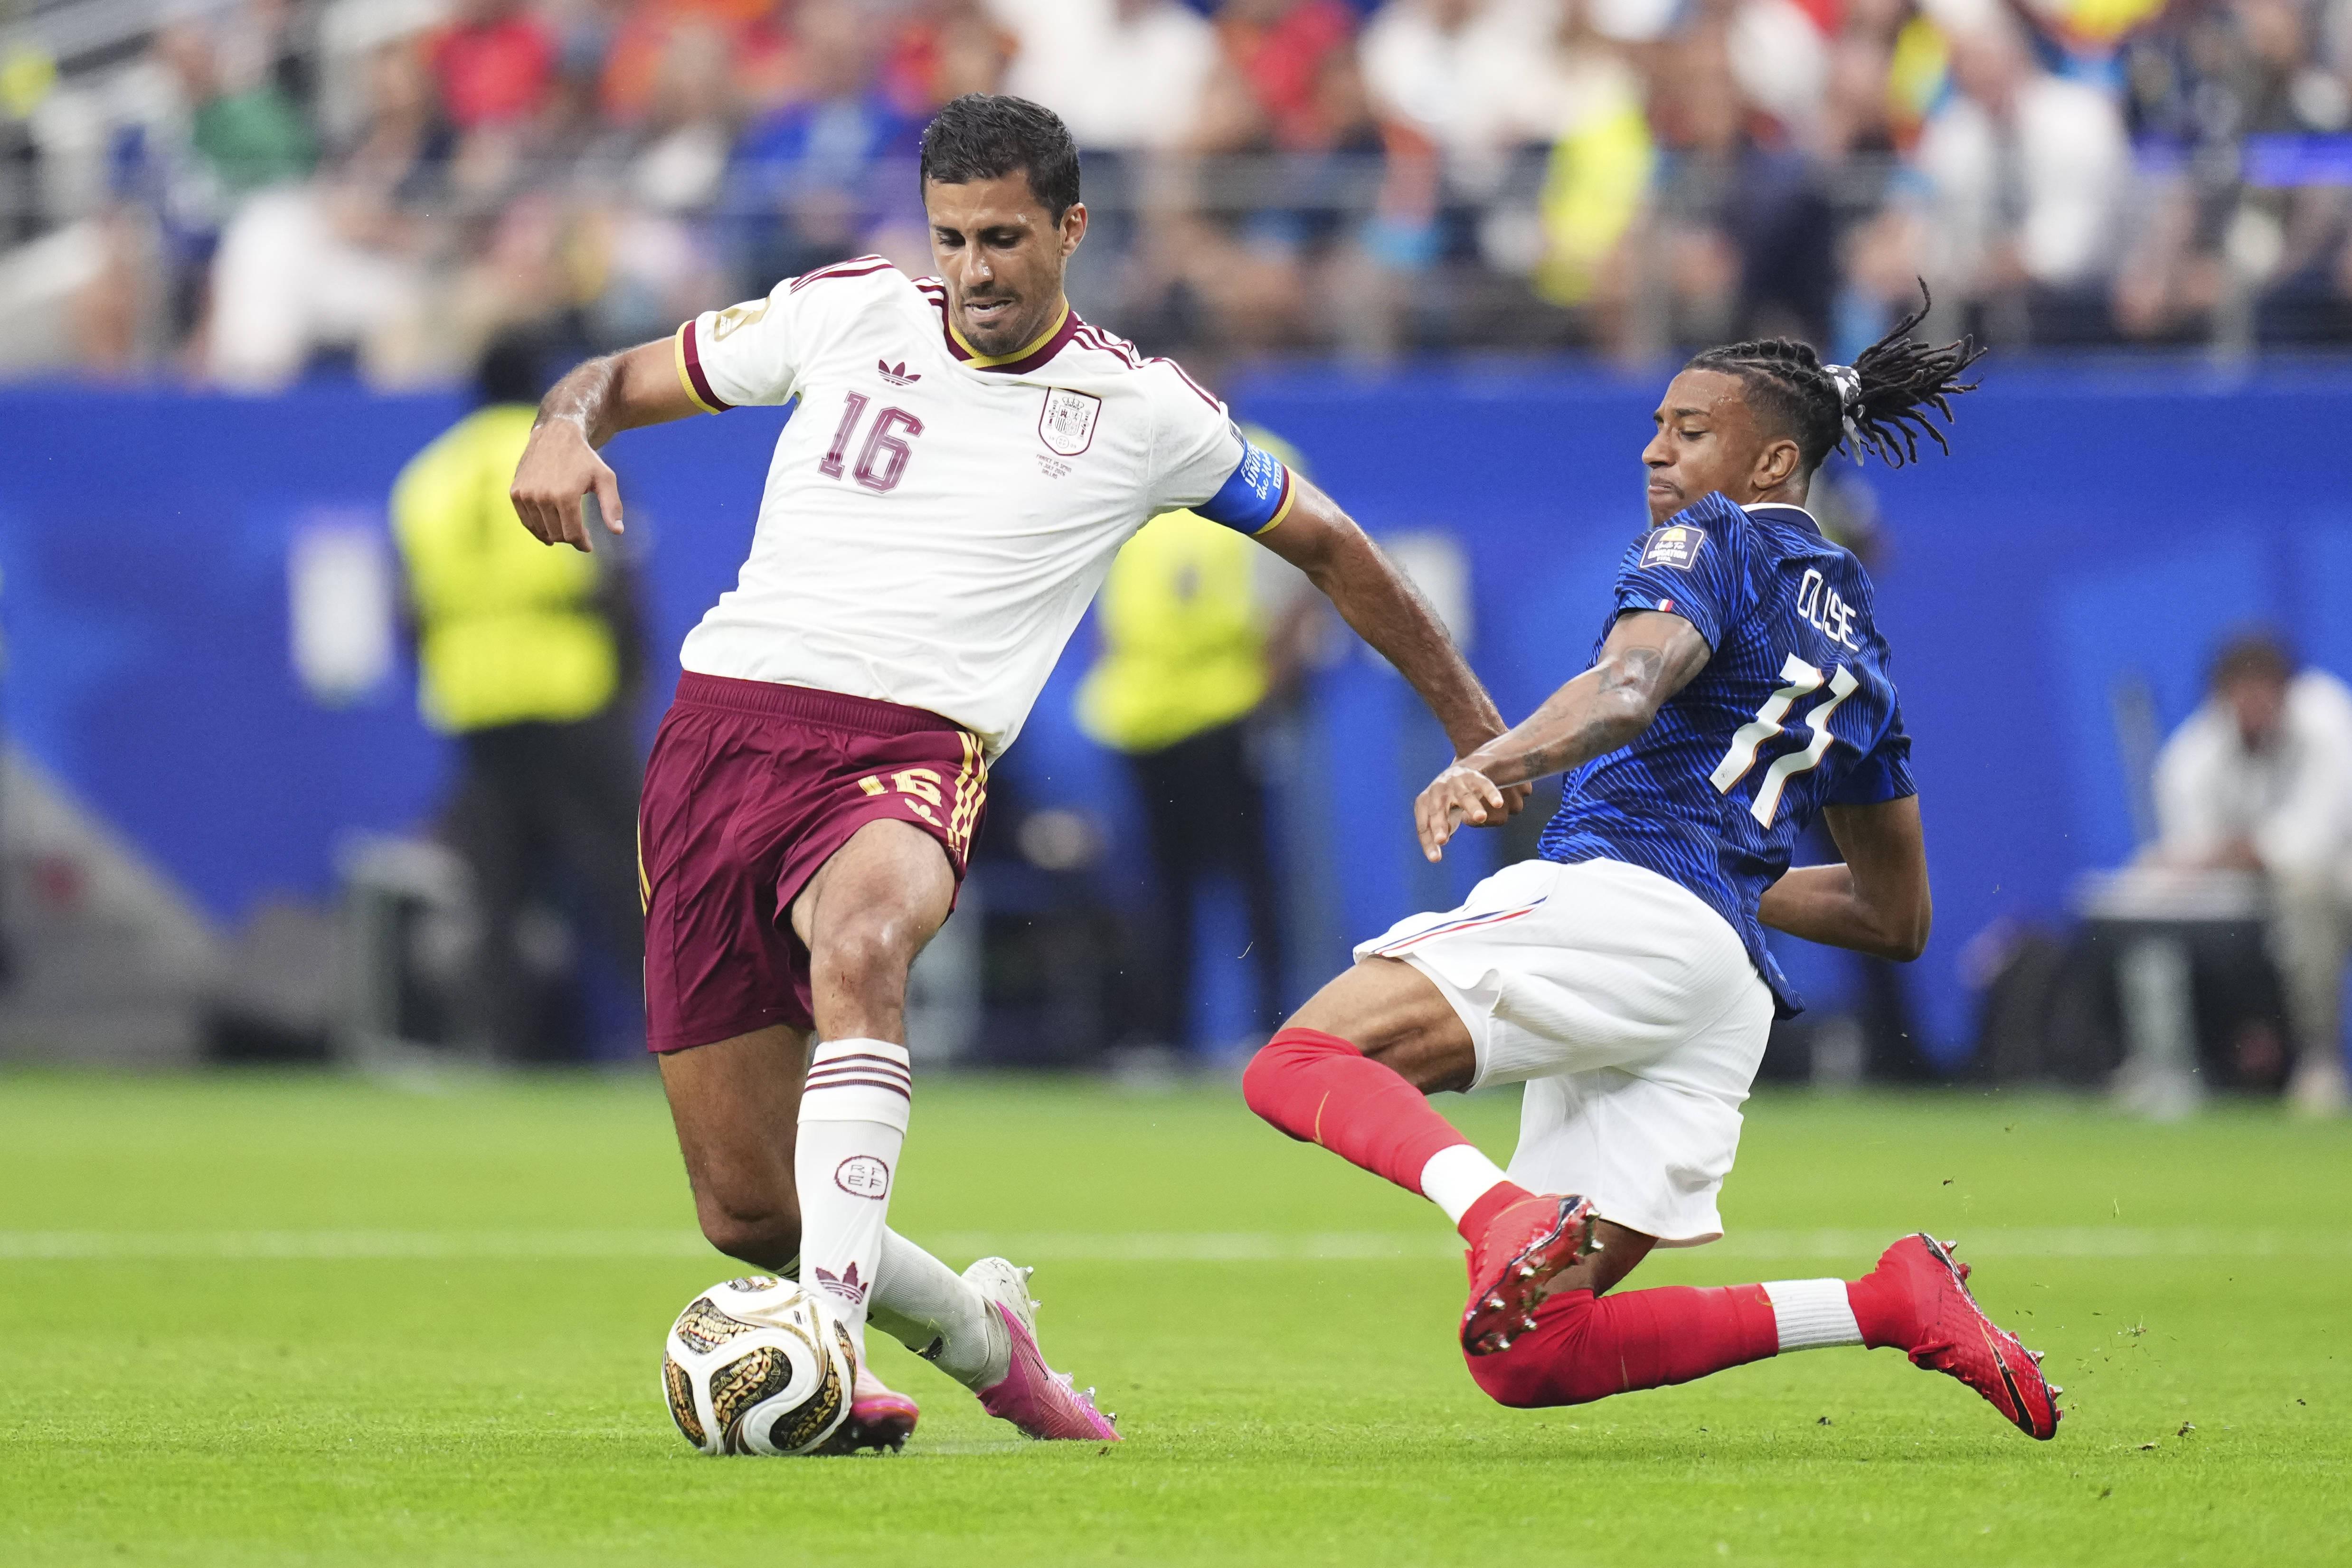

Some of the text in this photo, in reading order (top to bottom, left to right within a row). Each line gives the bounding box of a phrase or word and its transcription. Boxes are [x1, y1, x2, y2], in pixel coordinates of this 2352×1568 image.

[817, 390, 925, 494] 16
[1036, 454, 1052, 463] FRANCE
[1256, 478, 1269, 500] the
[1647, 549, 1688, 560] EDUCATION
[1797, 568, 1859, 652] OLISE
[1709, 652, 1860, 830] 11
